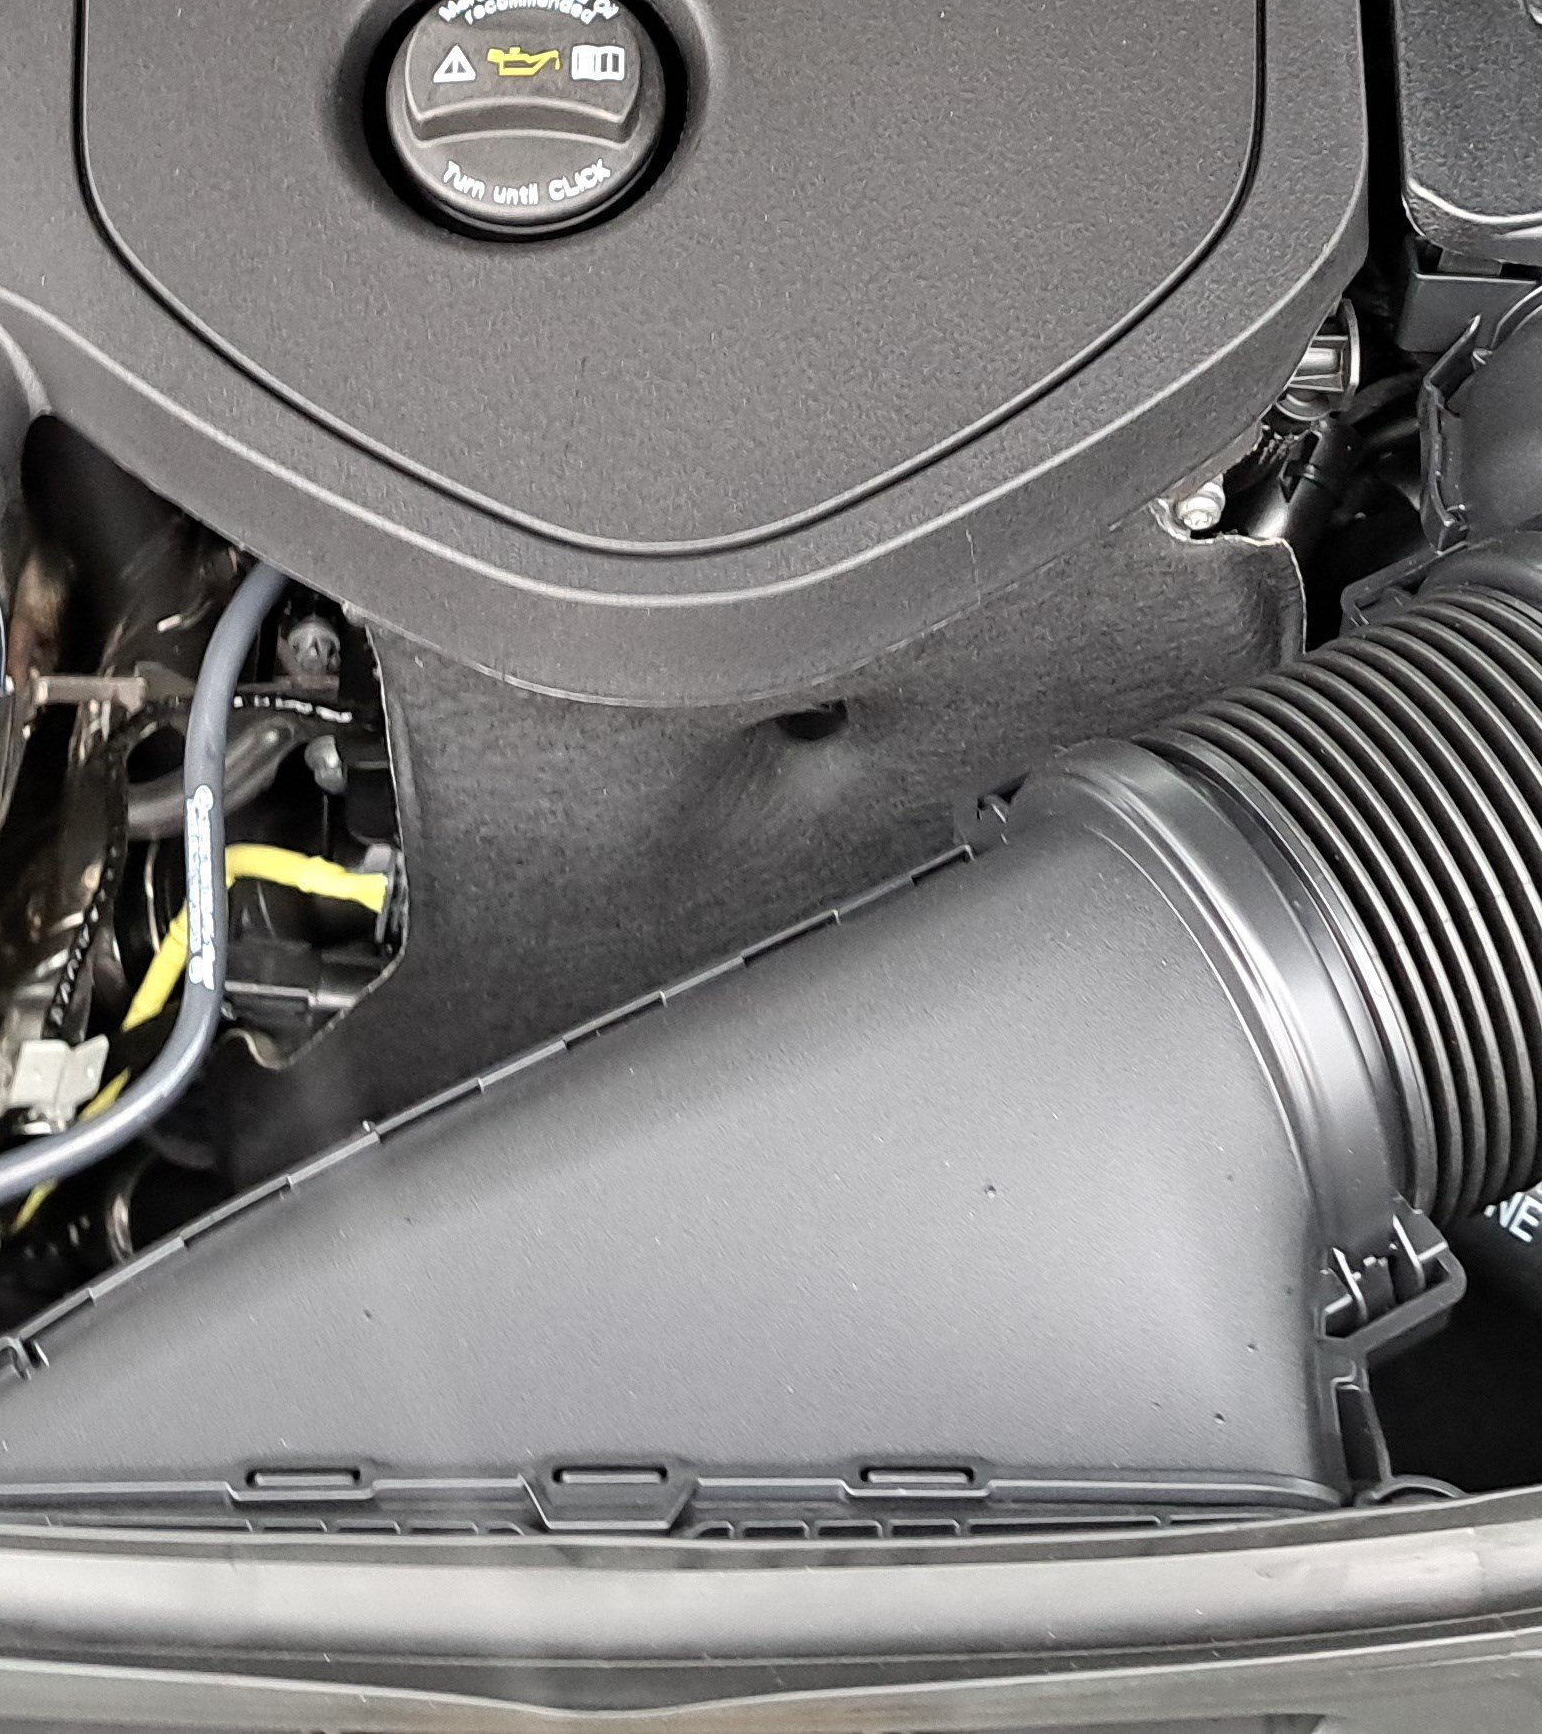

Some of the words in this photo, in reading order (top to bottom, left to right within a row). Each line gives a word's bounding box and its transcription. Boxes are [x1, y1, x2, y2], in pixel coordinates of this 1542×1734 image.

[443, 160, 486, 201] Turn
[493, 183, 539, 206] until
[548, 157, 611, 202] CLICK
